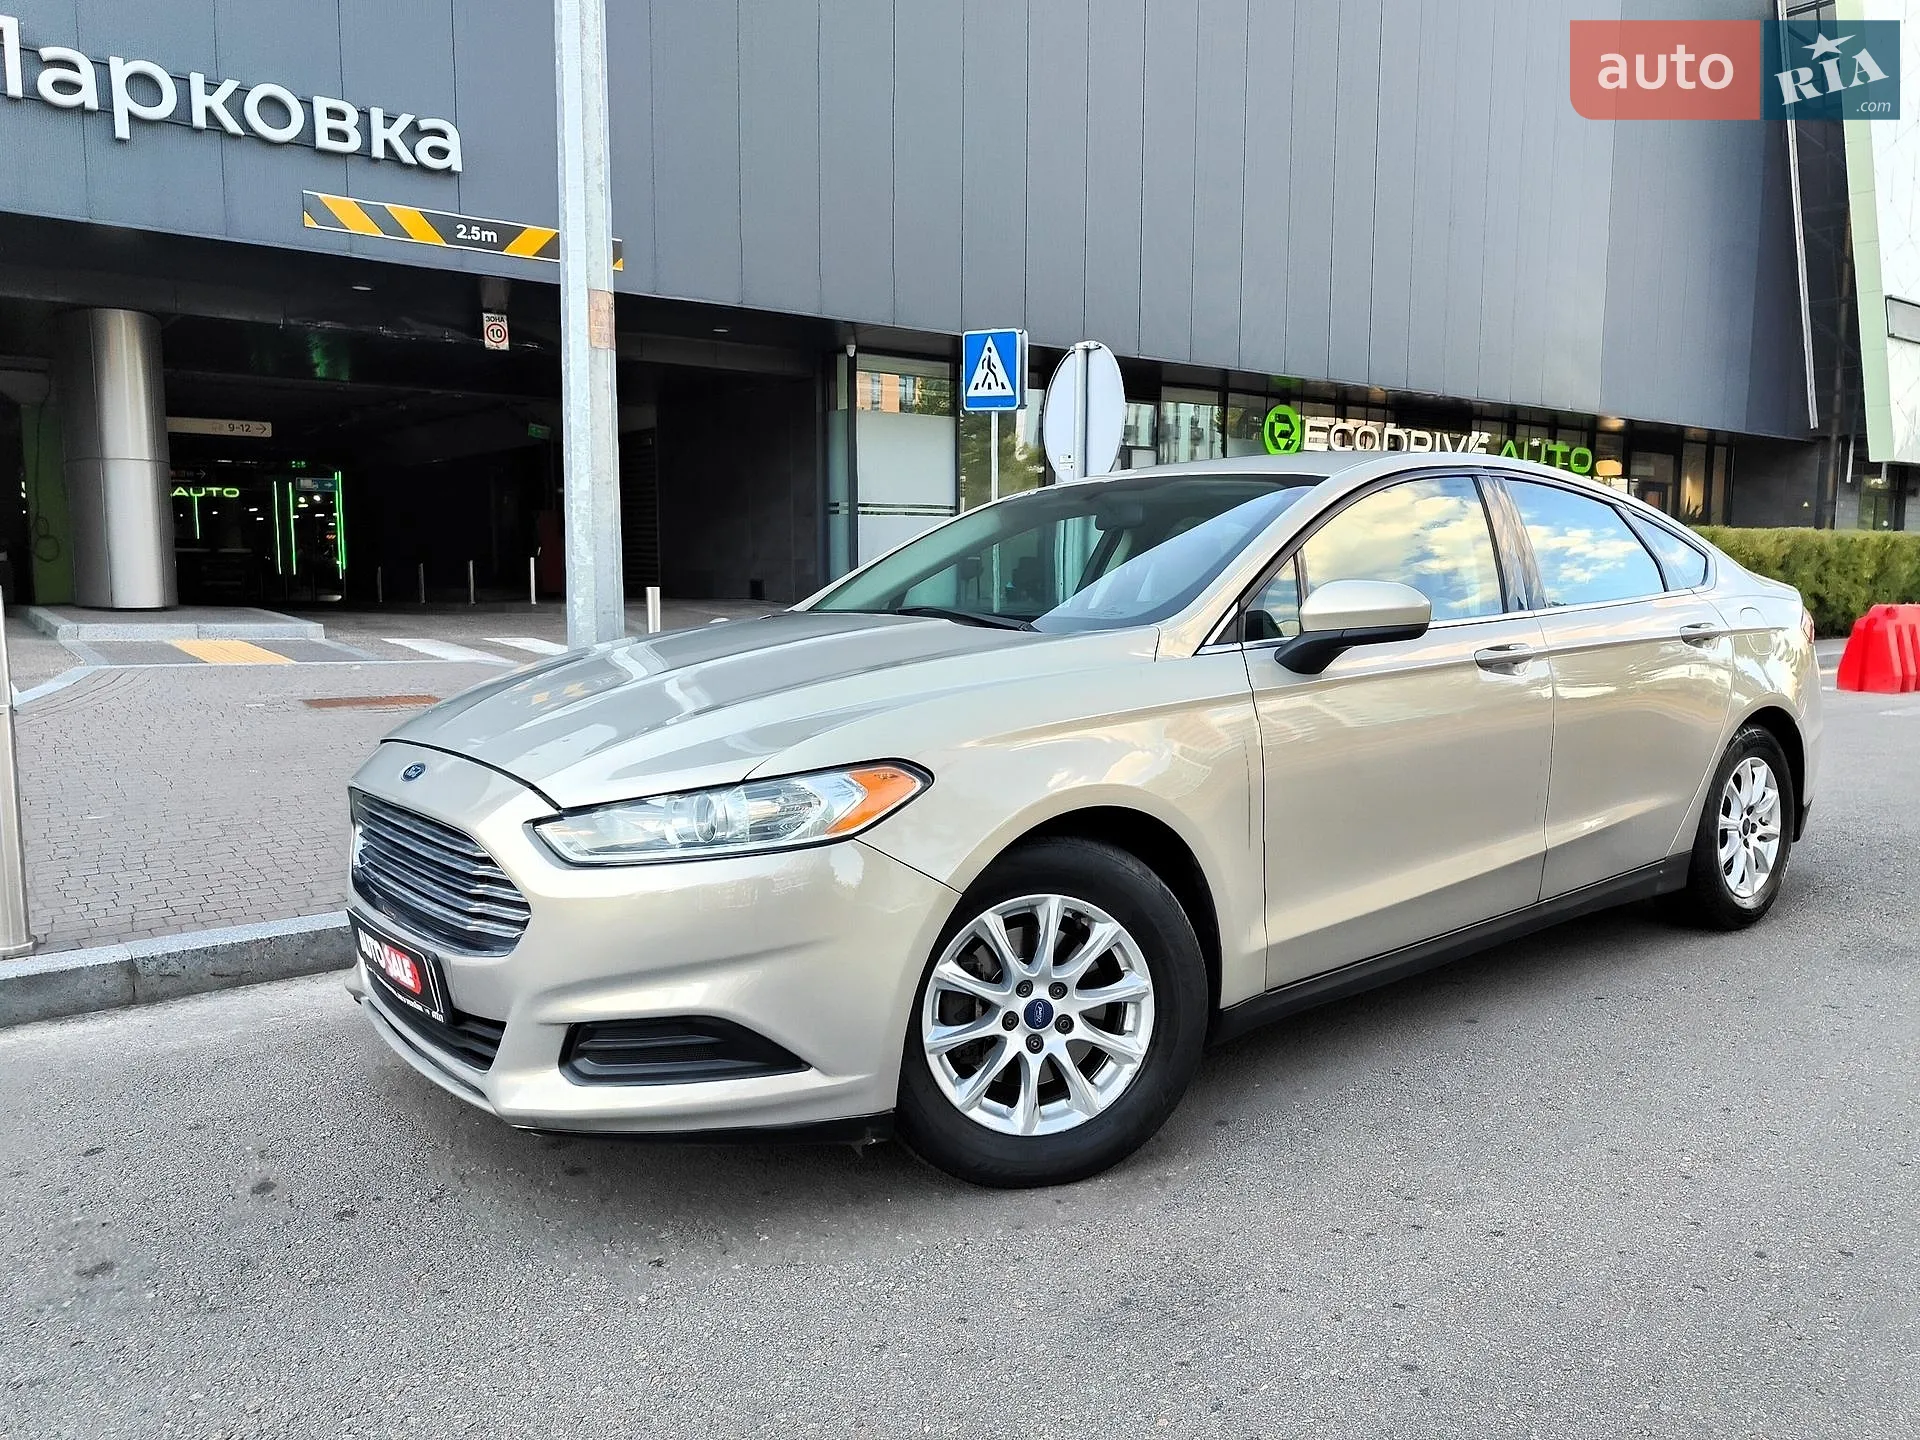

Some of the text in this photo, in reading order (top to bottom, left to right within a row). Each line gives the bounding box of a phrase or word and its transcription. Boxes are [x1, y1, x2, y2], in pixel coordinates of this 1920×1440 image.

[456, 223, 498, 243] 2.5m
[490, 328, 503, 338] 10
[228, 423, 251, 432] 9-12
[172, 486, 240, 498] AUTO
